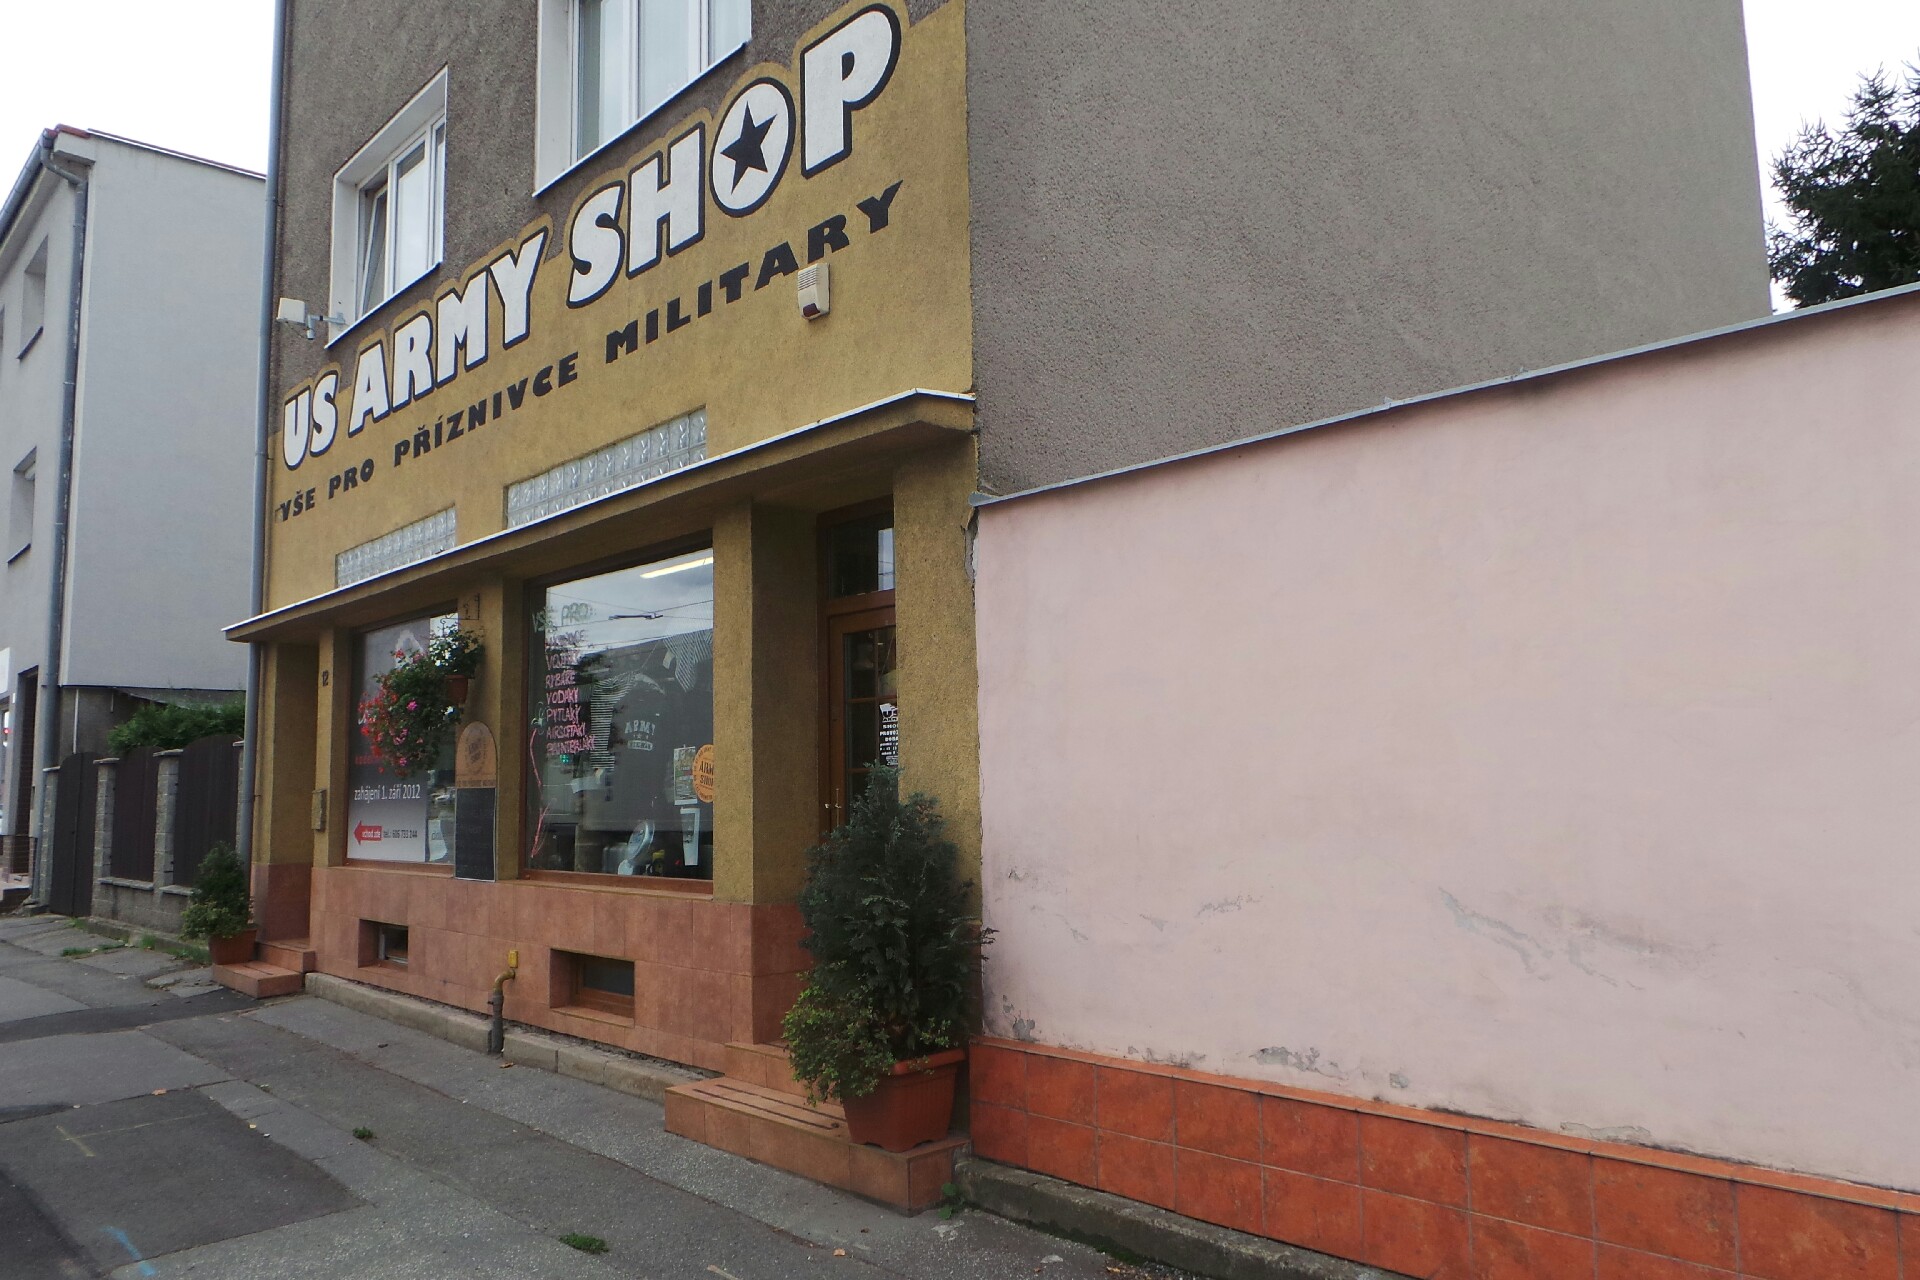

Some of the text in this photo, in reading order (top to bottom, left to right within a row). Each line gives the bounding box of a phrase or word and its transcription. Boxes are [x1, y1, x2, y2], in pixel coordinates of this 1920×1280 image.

[283, 4, 902, 470] US ARMY SHOP
[328, 458, 375, 499] PRO
[394, 352, 579, 467] PŘÍZNIVCE
[606, 179, 904, 364] MILITARY
[354, 784, 381, 803] zahájení
[402, 784, 421, 799] 2012
